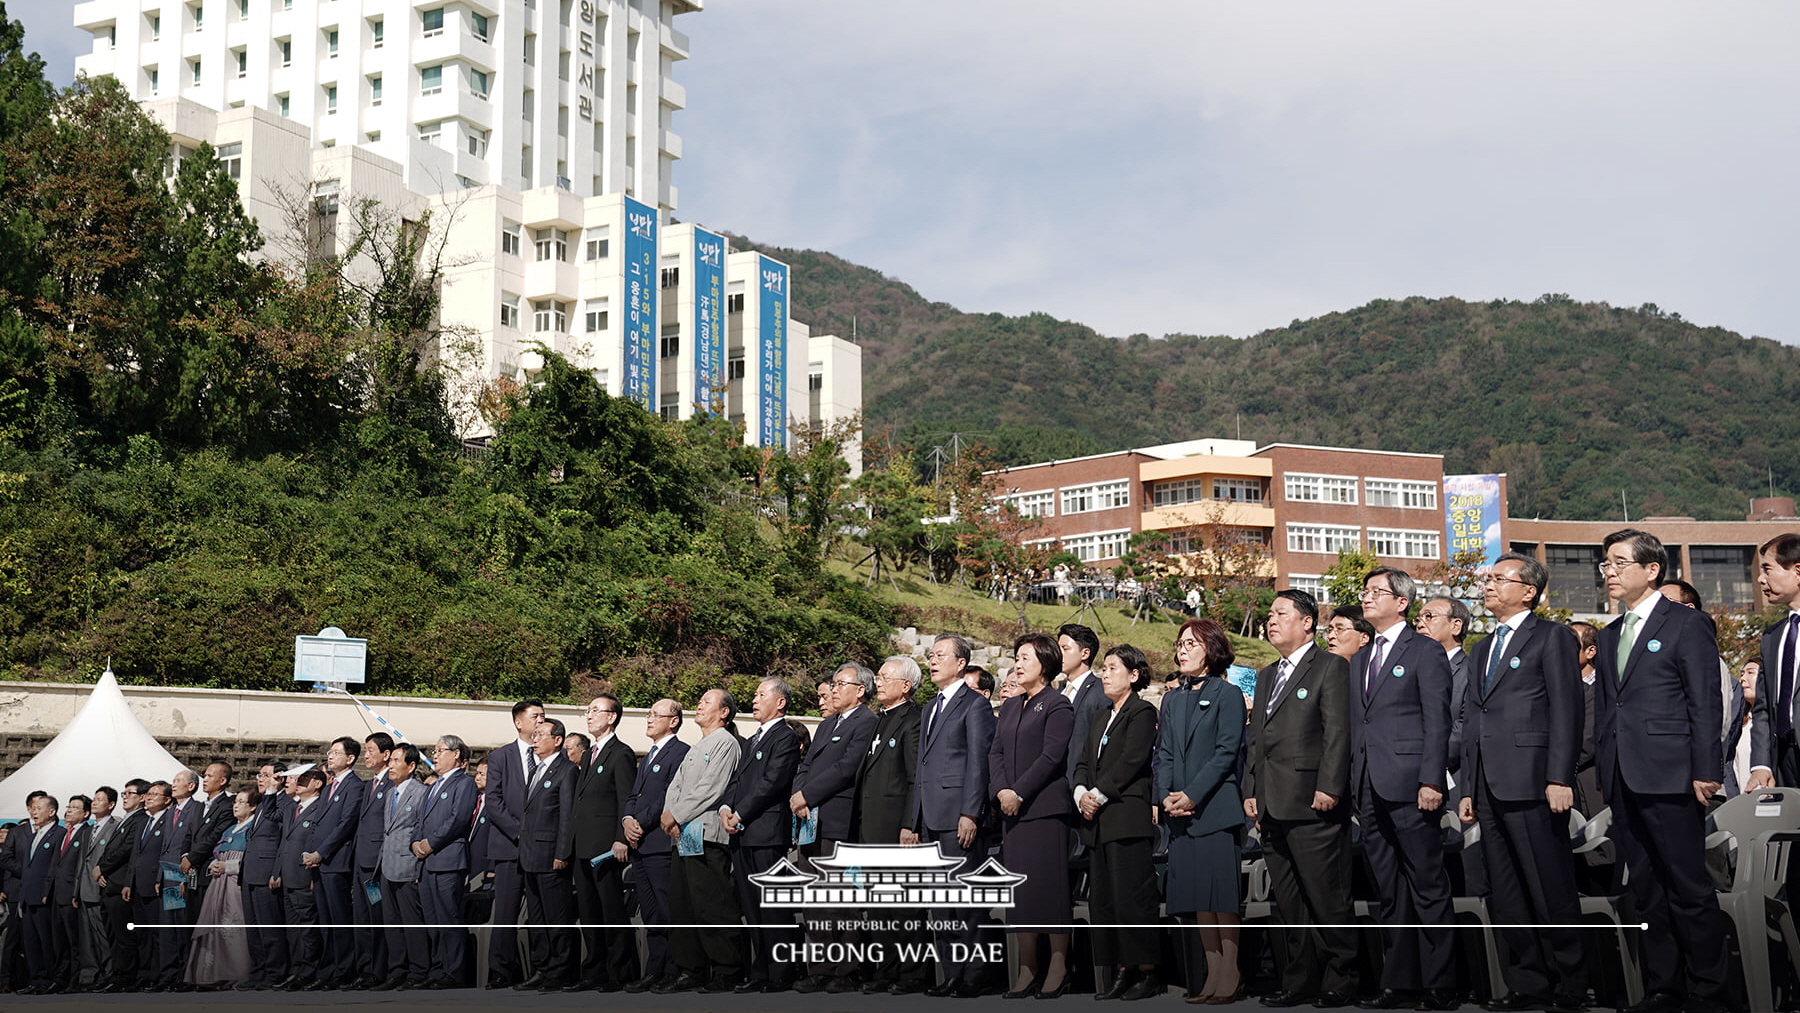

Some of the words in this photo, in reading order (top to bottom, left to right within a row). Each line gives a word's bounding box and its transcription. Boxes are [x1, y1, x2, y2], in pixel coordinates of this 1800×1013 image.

[630, 262, 641, 275] 그
[630, 330, 639, 358] 여기
[1449, 494, 1483, 507] 2018
[1452, 508, 1482, 523] 중앙
[1452, 523, 1483, 538] 일보
[1453, 536, 1483, 551] 대학
